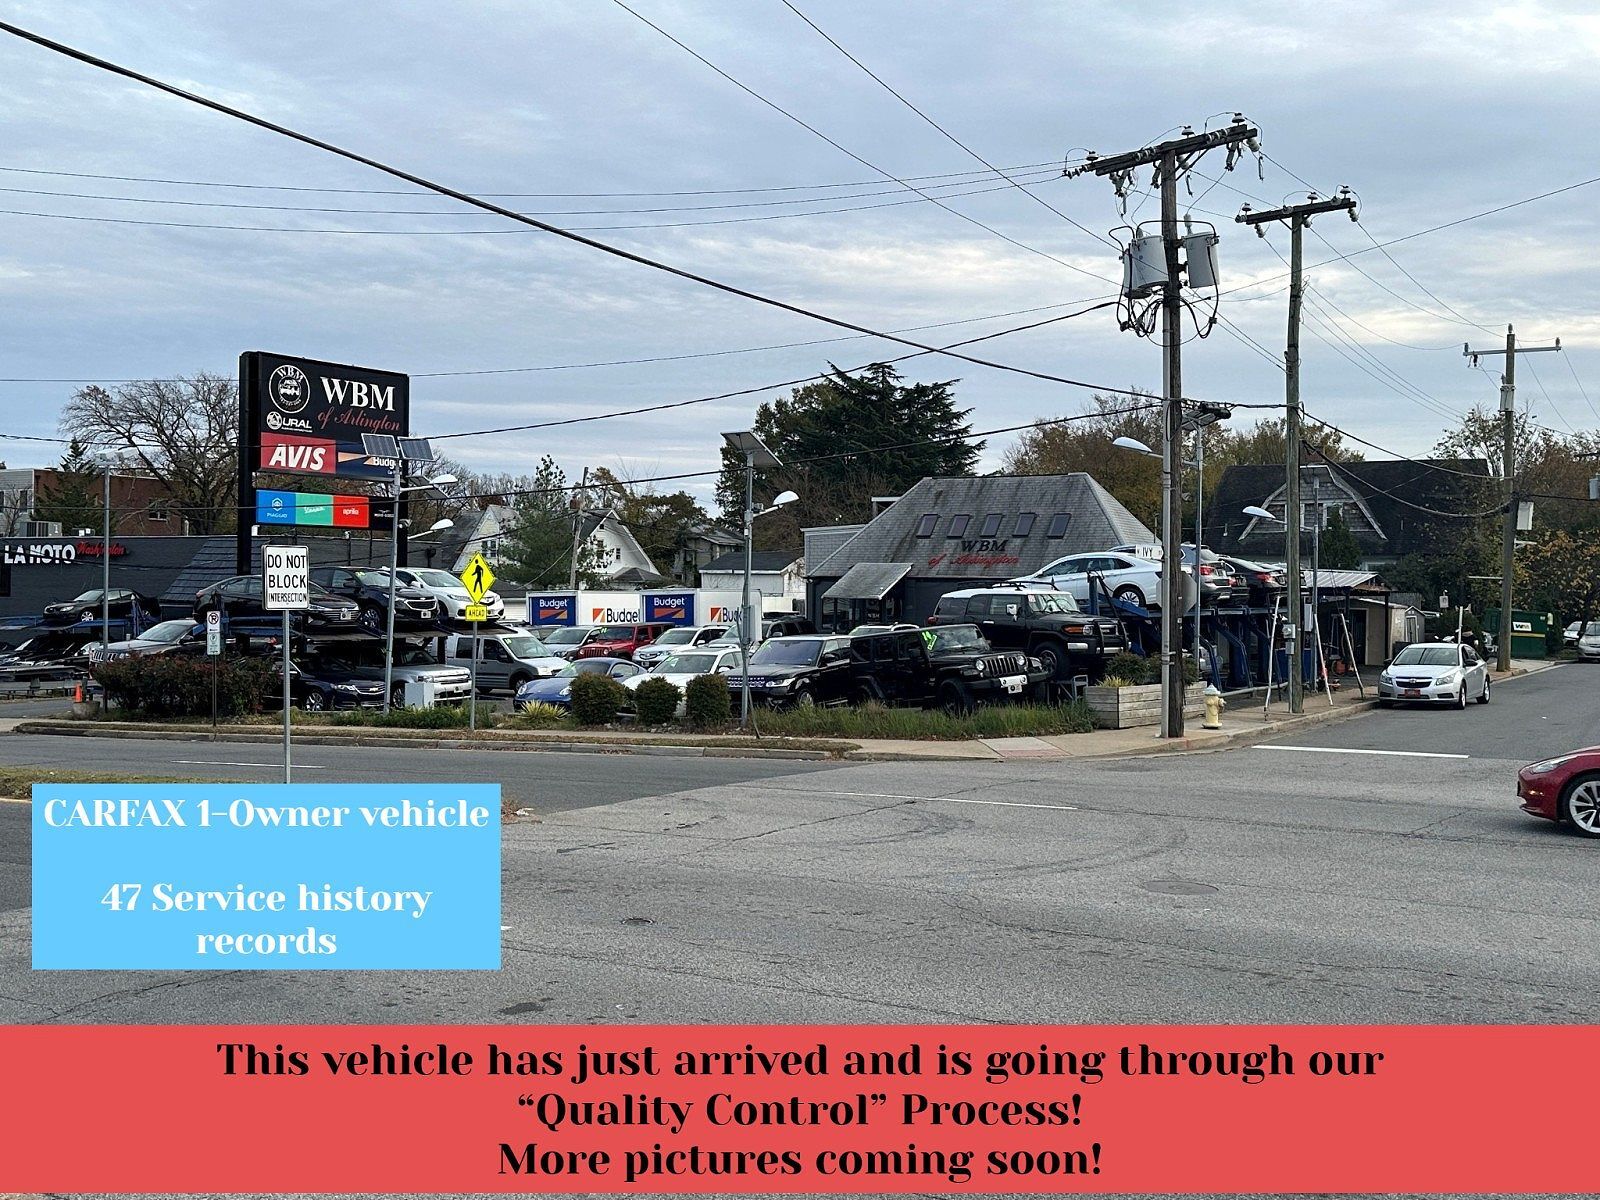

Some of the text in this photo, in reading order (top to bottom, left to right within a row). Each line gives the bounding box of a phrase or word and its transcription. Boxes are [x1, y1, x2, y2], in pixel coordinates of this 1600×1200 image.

[276, 366, 305, 382] WBM
[320, 376, 396, 412] WBM
[282, 417, 313, 429] URAL
[317, 406, 401, 434] of Arlington
[268, 443, 327, 471] AVIS
[373, 456, 402, 469] Budgt
[961, 539, 1009, 552] WBM
[1142, 546, 1153, 557] IVY
[4, 544, 76, 564] LA MOTO
[267, 554, 306, 568] DO NOT
[268, 574, 307, 588] BLOCK
[268, 593, 307, 602] INTERSECTION
[539, 599, 568, 609] Budget
[653, 597, 685, 608] Budget
[469, 609, 486, 617] AHEAD
